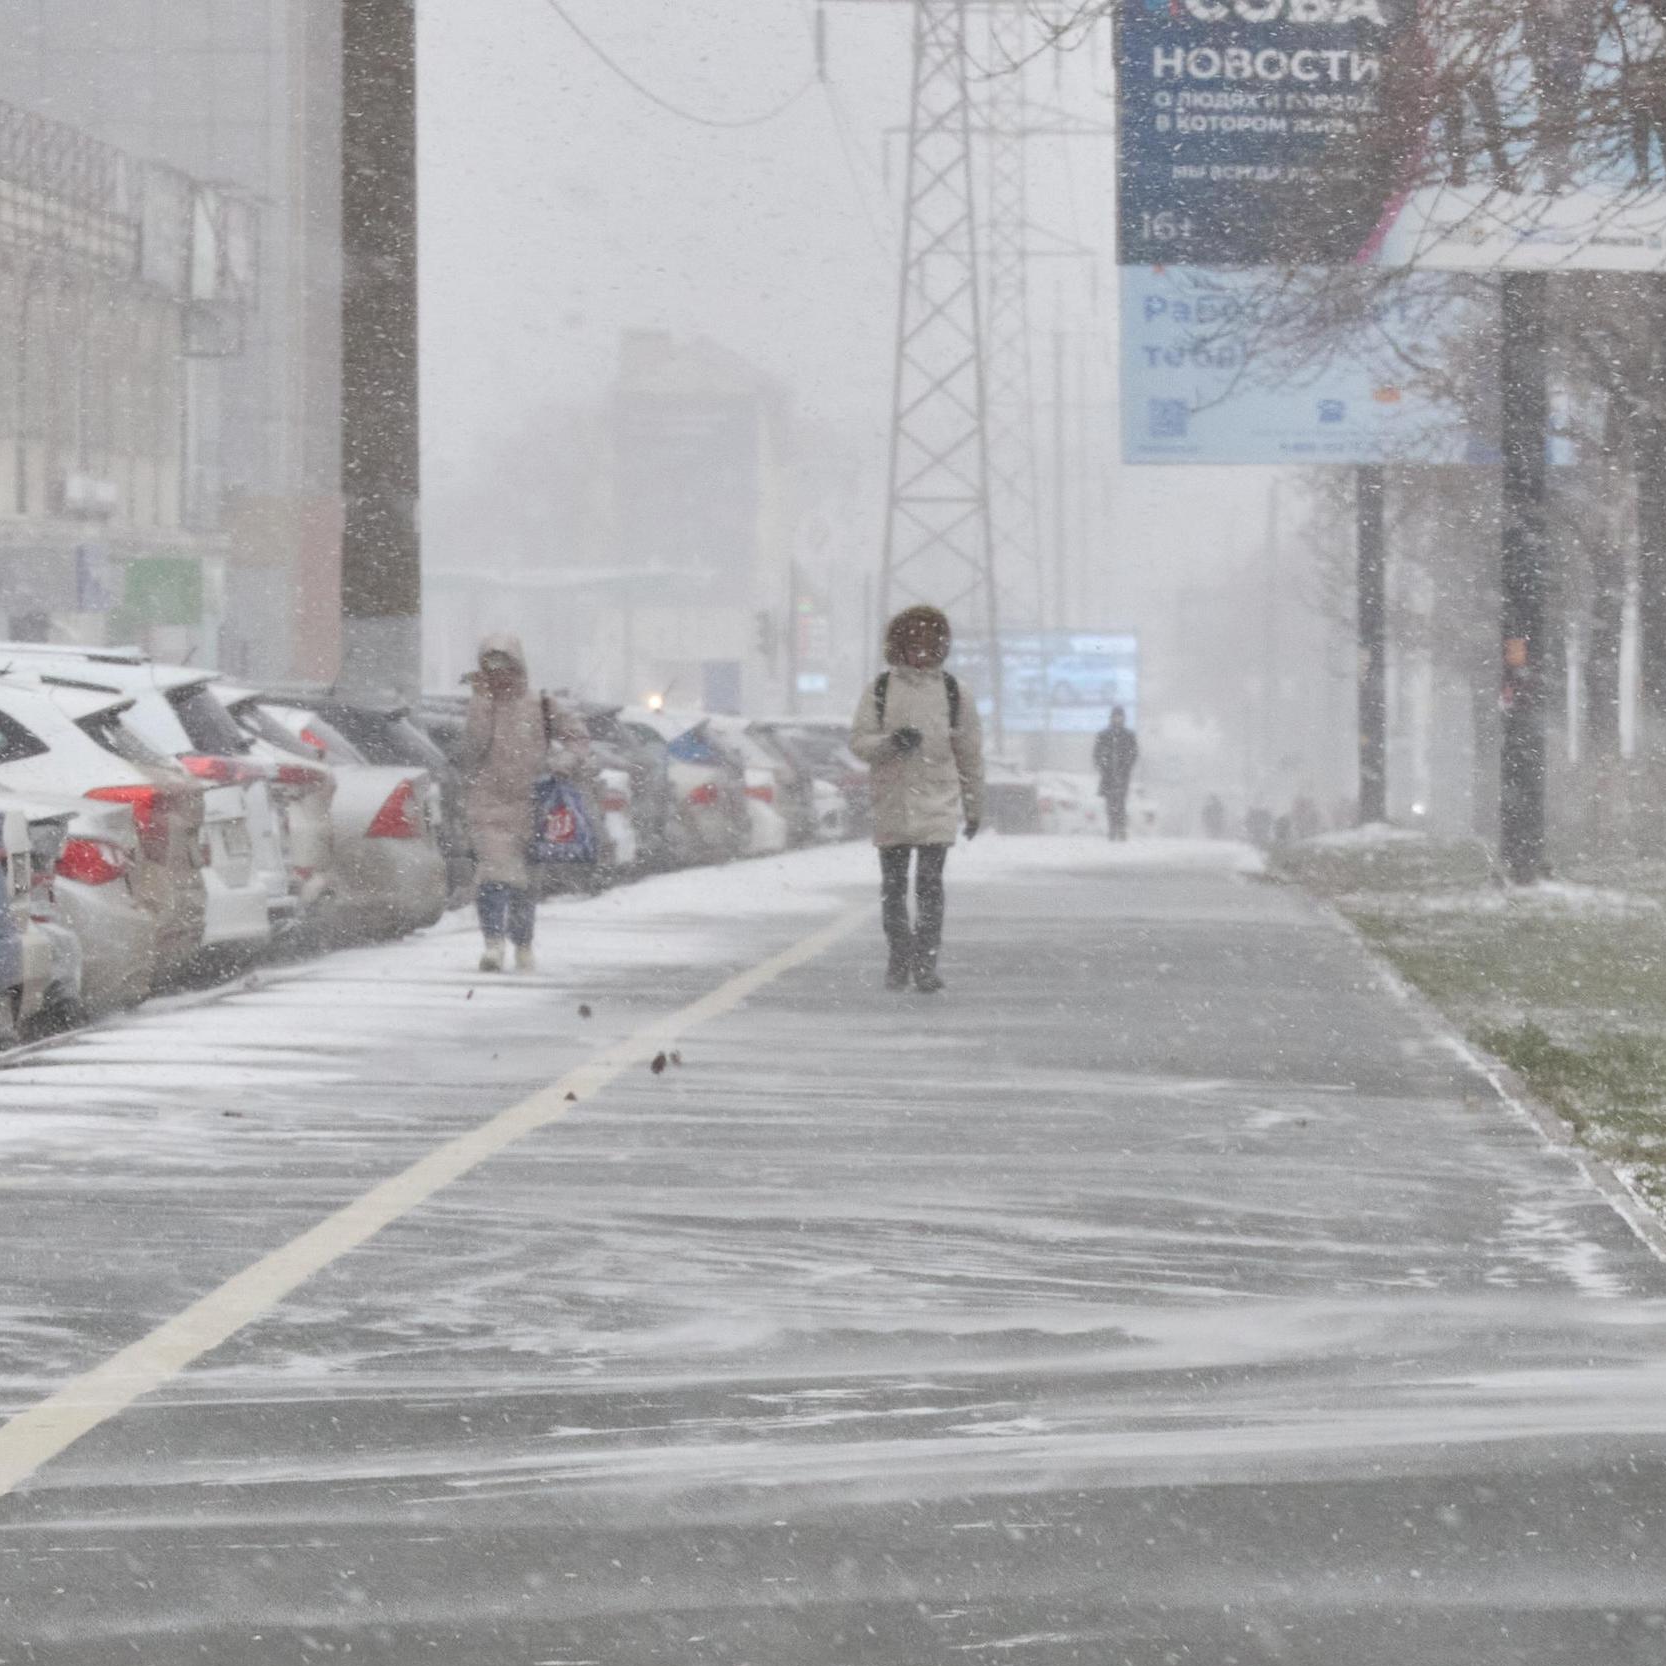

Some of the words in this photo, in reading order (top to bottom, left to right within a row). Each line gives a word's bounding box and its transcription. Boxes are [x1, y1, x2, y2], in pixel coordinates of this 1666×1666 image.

[1153, 47, 1381, 81] НОВОСТИ
[1154, 91, 1172, 107] О
[1178, 91, 1260, 110] ЛЮДЯХ
[1156, 115, 1171, 132] В
[1176, 115, 1287, 133] КОТОРОМ
[1141, 211, 1193, 240] 16+
